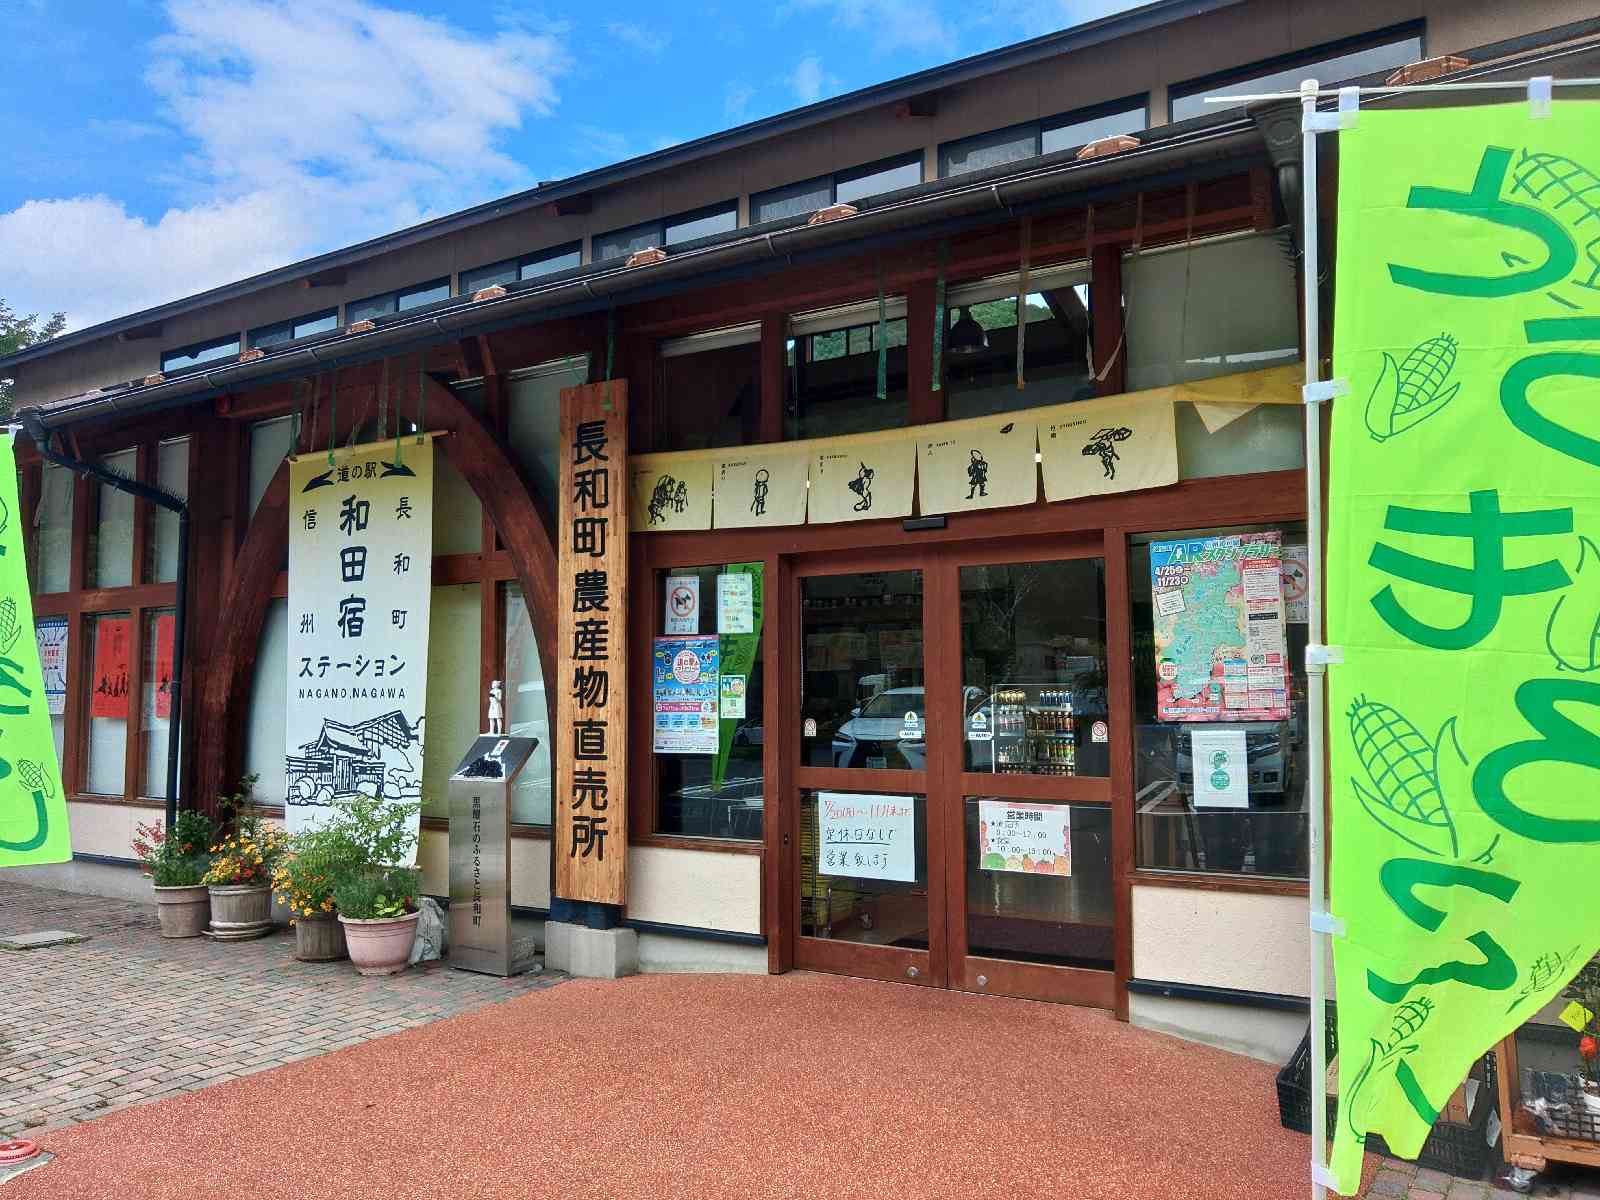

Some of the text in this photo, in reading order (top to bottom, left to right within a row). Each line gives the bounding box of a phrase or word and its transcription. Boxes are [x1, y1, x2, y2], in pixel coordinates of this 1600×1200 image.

[336, 462, 377, 483] 道の駅
[300, 508, 318, 634] 信州
[337, 494, 370, 639] 和田宿
[390, 496, 412, 630] 長和町
[299, 654, 406, 679] ステーション
[570, 420, 610, 862] 長和町農産物直売所
[1006, 810, 1042, 821] 営業時間
